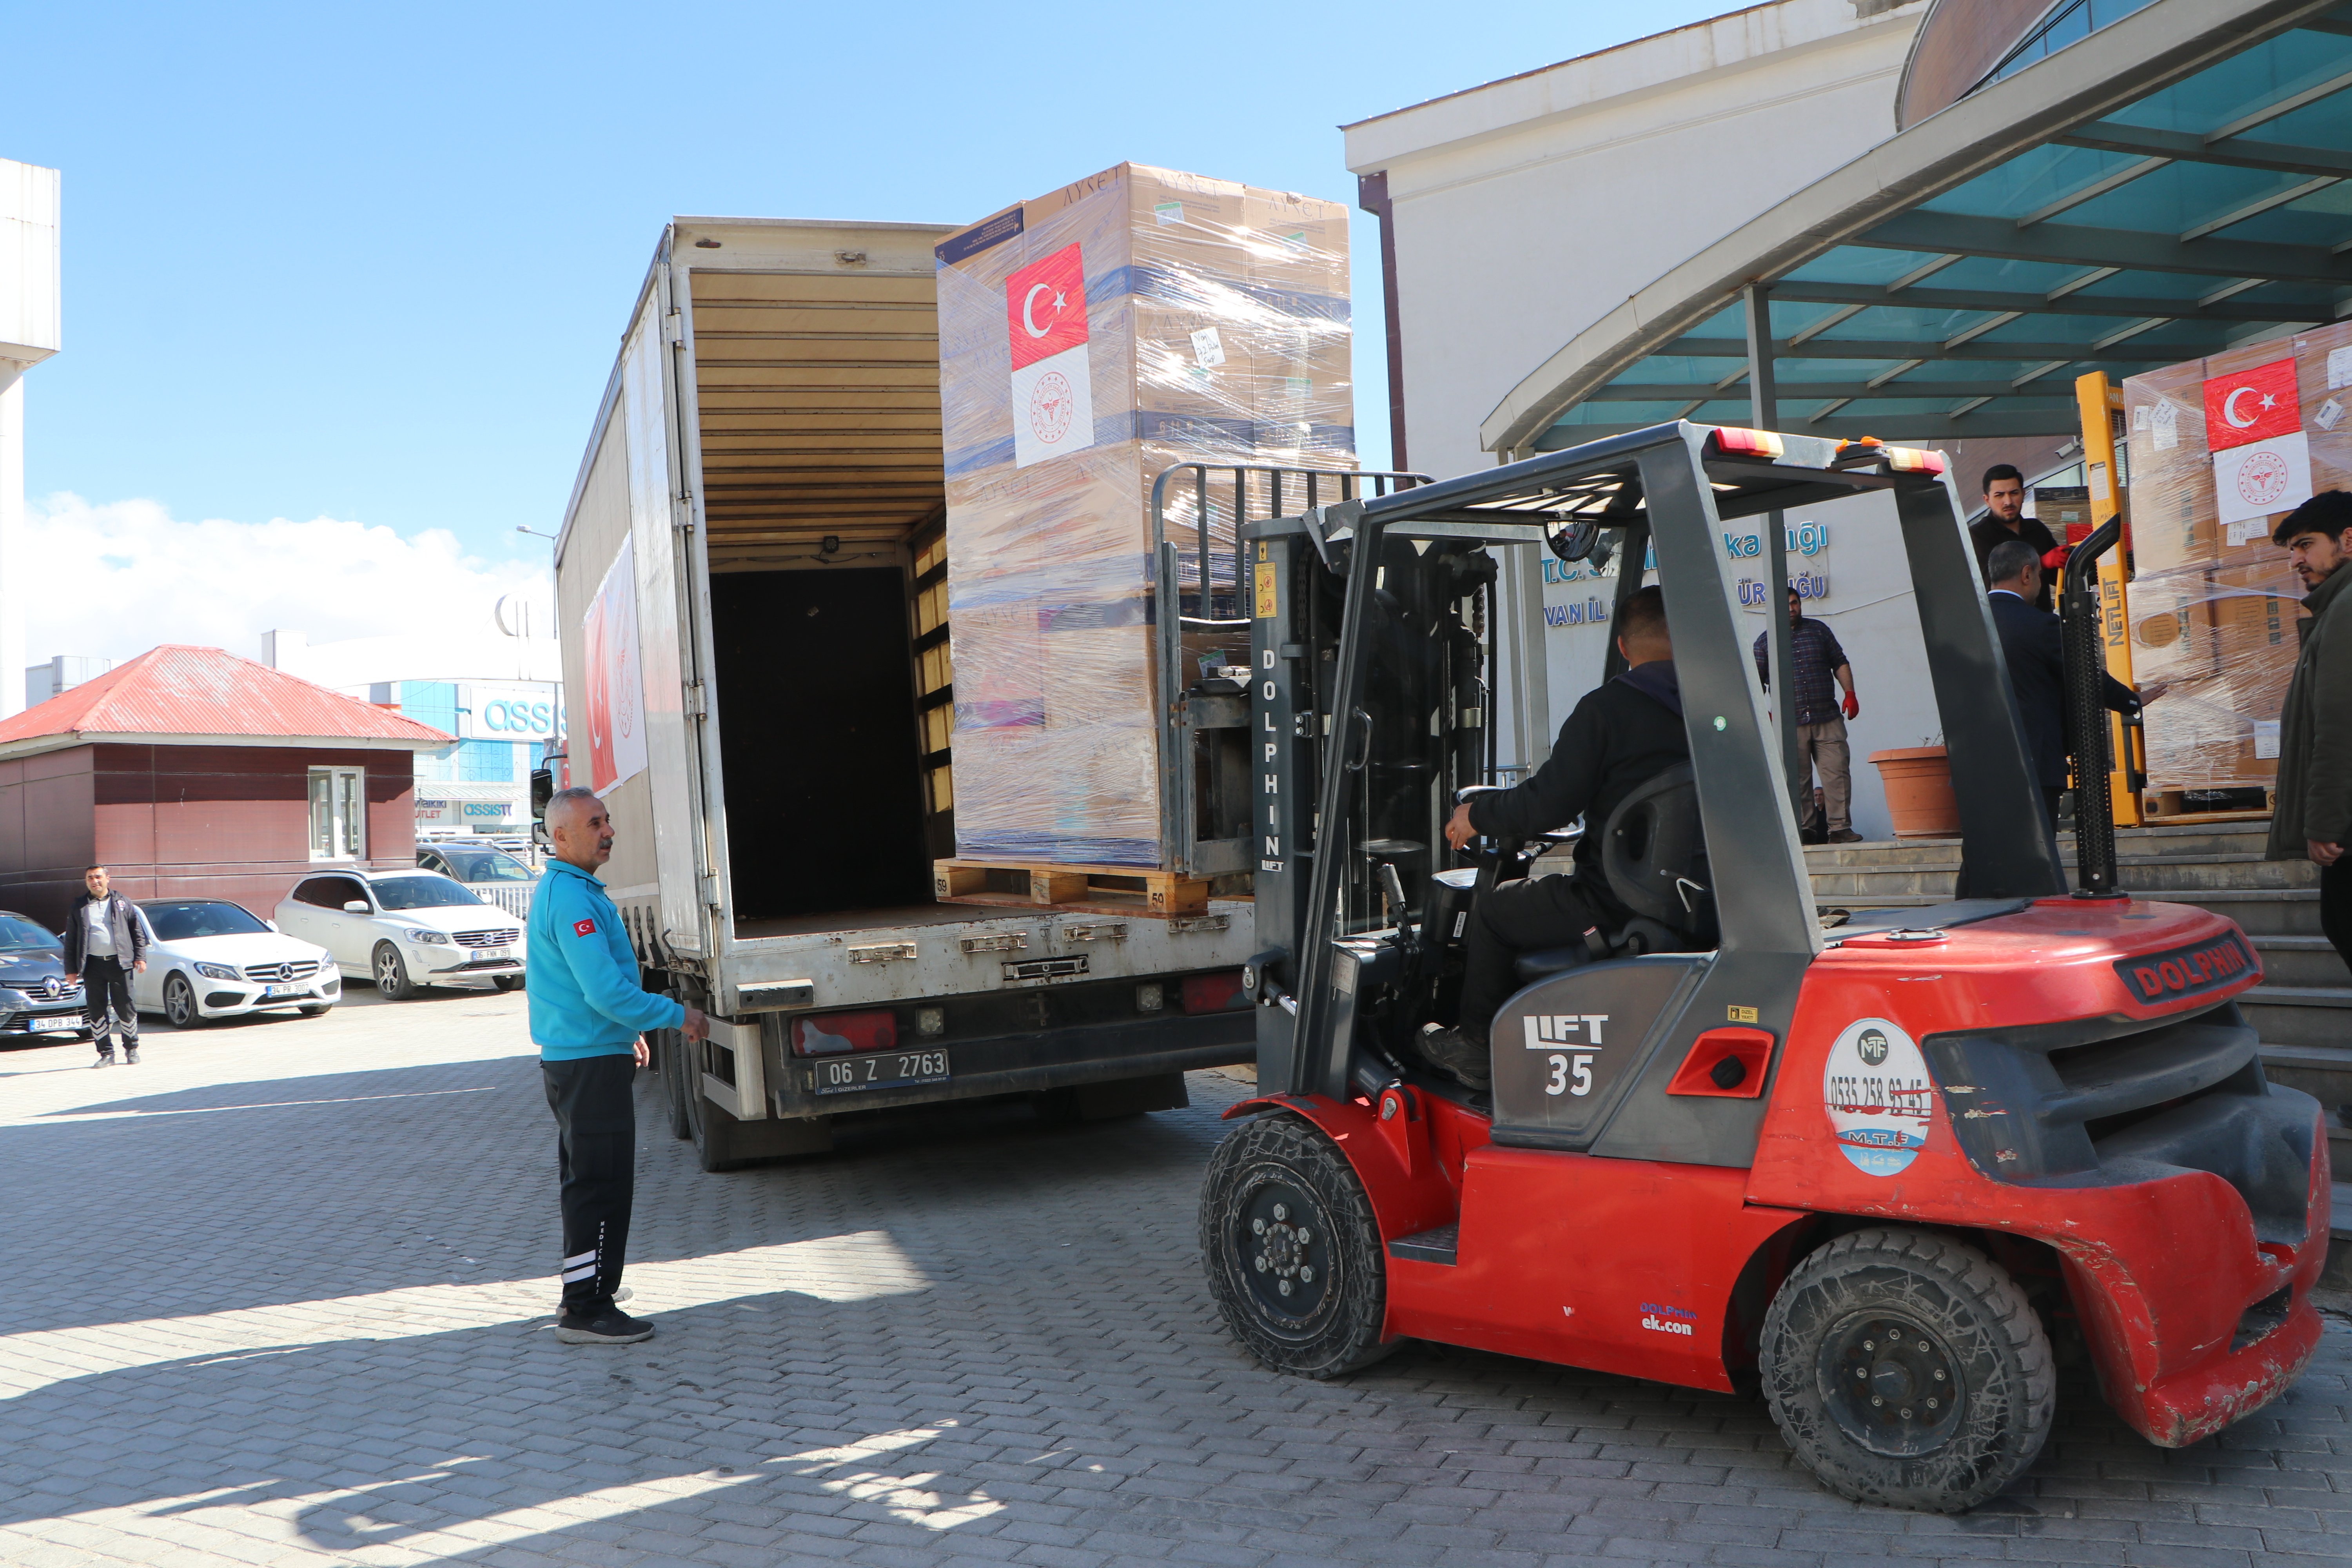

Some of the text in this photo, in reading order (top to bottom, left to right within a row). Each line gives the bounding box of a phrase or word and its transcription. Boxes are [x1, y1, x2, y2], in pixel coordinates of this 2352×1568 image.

[1543, 602, 1583, 627] VAN
[2102, 577, 2124, 647] NETLIFT
[1263, 649, 1279, 856] DOLPHIN
[1261, 859, 1284, 872] LIFT
[937, 879, 947, 892] 59
[1152, 893, 1164, 907] 59
[2134, 940, 2247, 996] DOLPHIN
[295, 984, 309, 992] 3002
[36, 1018, 80, 1028] 34 DPB 344
[1523, 1014, 1609, 1051] LIFT
[1861, 1036, 1886, 1058] MTF
[829, 1053, 945, 1085] 06 Z 2763
[1544, 1054, 1593, 1096] 35
